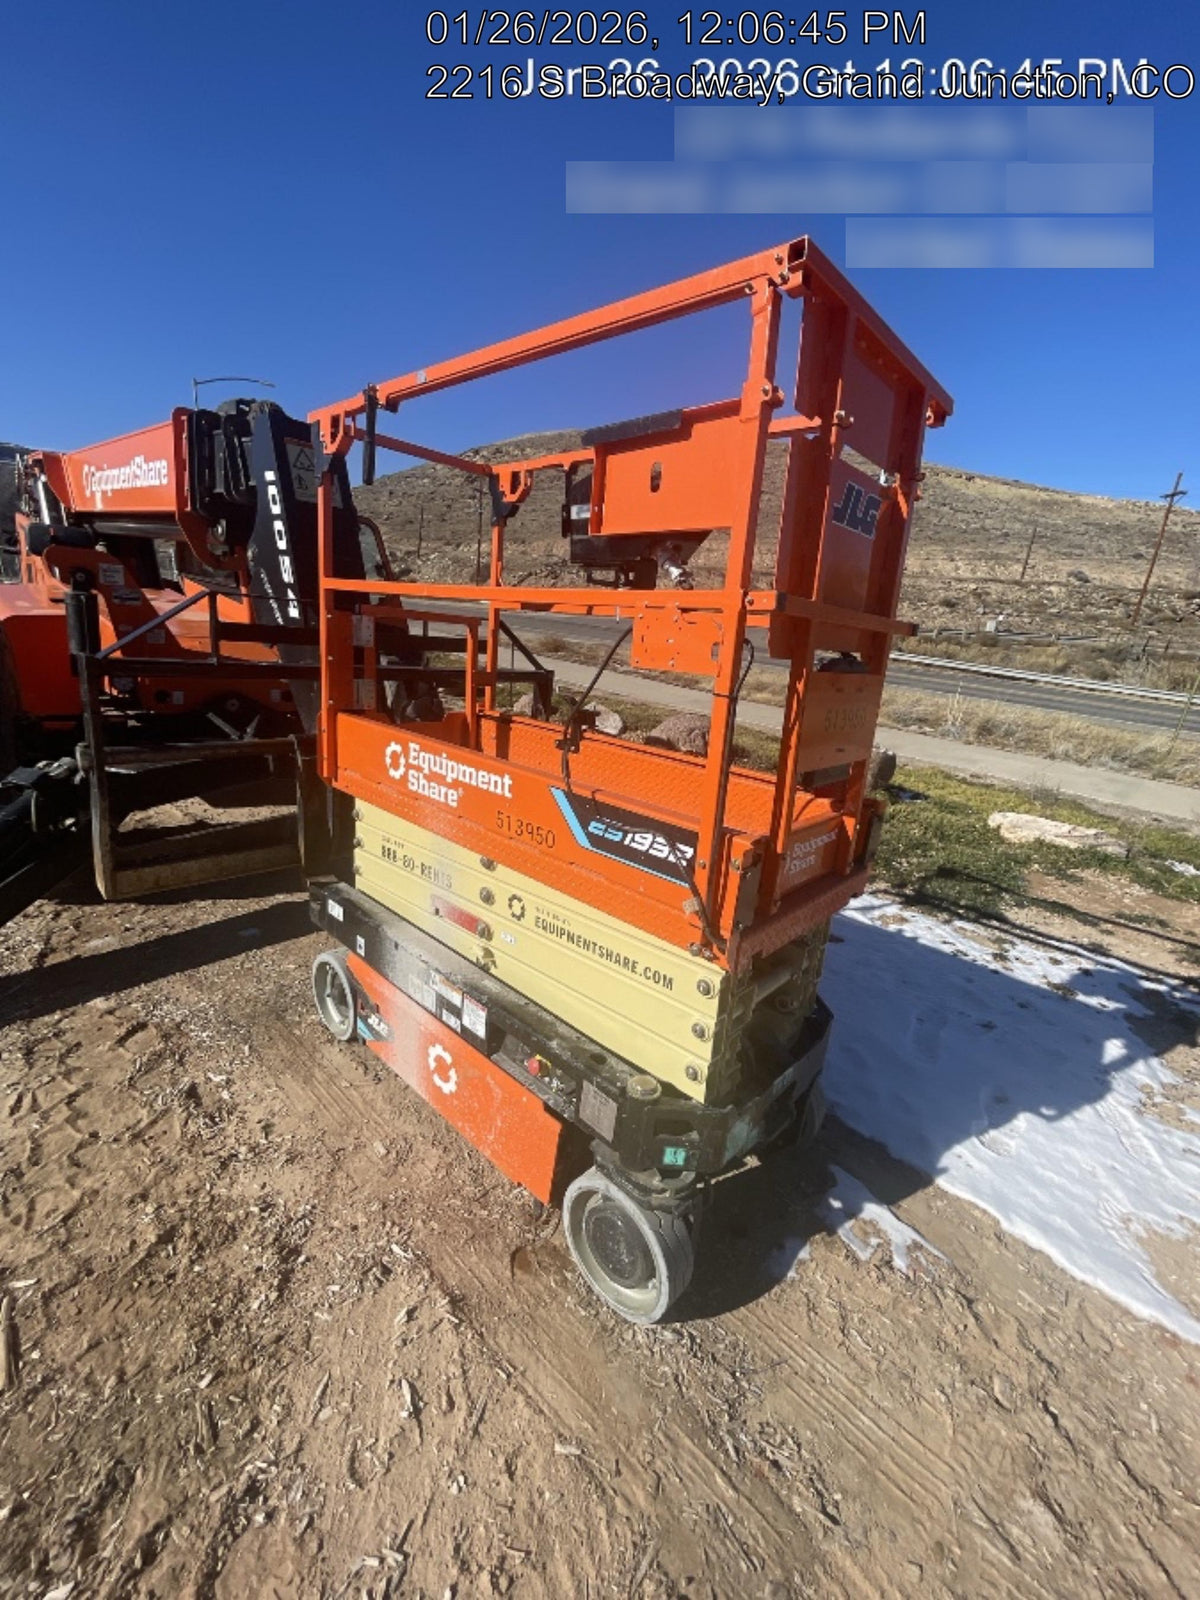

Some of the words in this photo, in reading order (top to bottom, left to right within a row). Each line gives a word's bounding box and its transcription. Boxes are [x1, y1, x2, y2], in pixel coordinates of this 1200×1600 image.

[831, 480, 882, 539] JLG
[408, 742, 513, 799] Equipment
[495, 810, 557, 849] 513950
[534, 915, 675, 991] EQUIPMENTSHARE.COM
